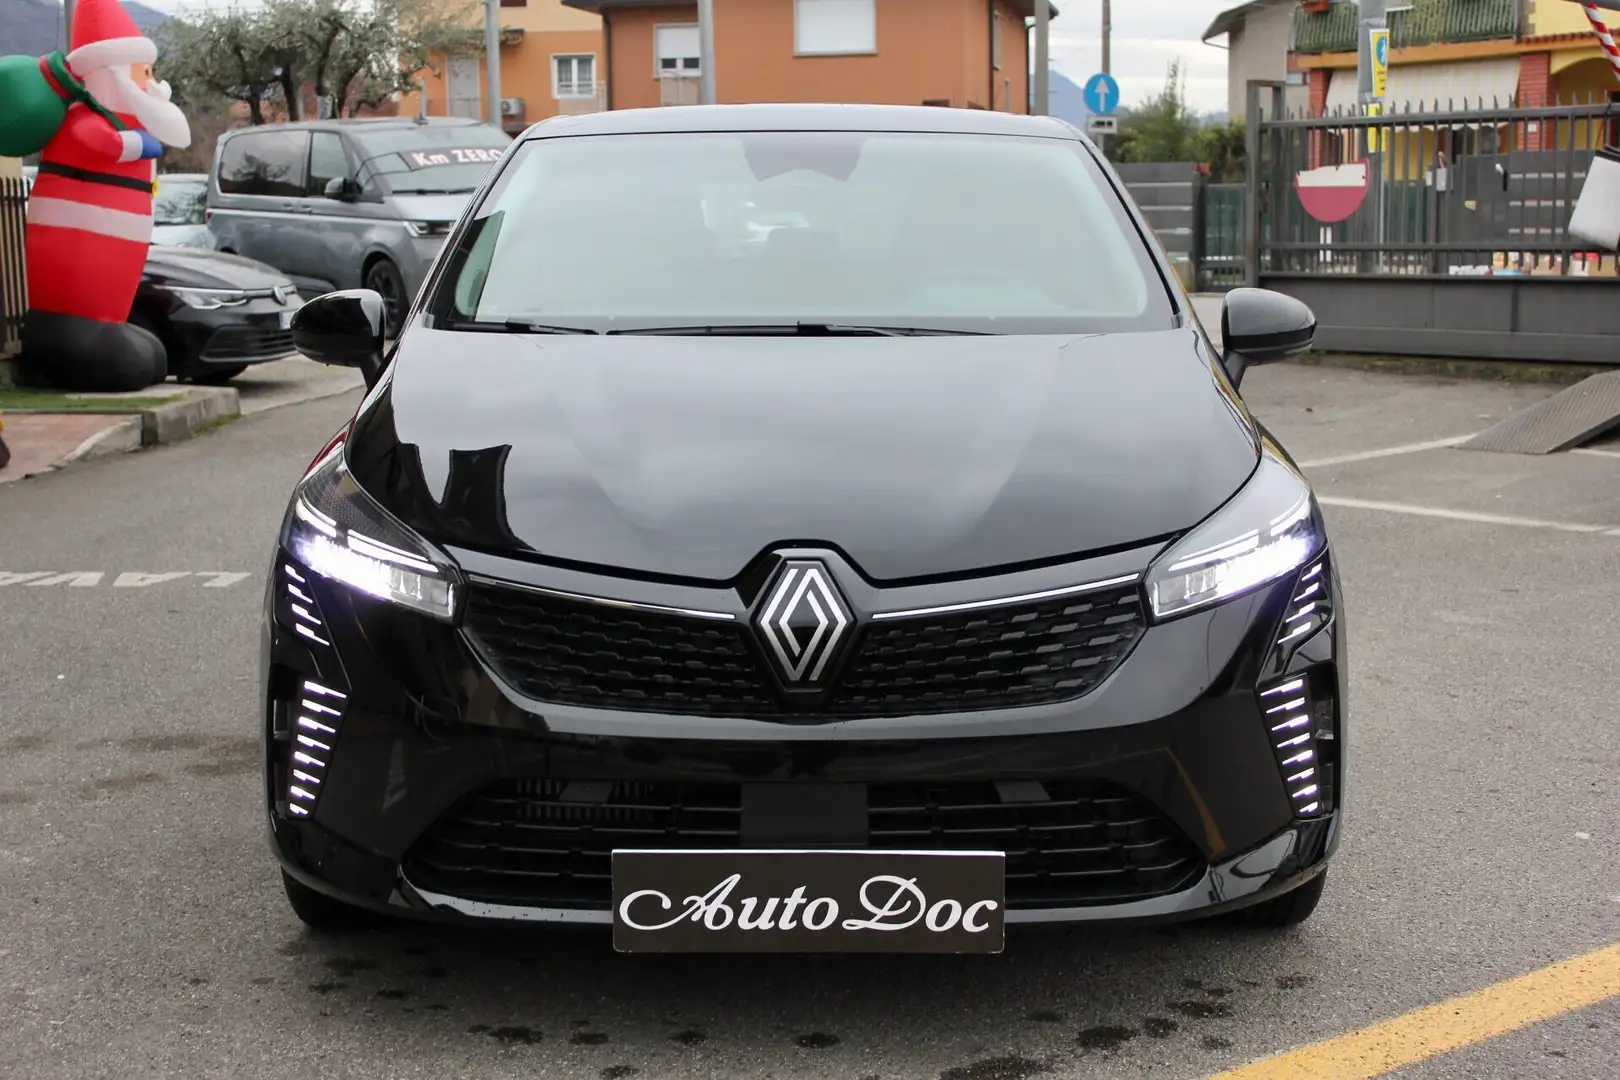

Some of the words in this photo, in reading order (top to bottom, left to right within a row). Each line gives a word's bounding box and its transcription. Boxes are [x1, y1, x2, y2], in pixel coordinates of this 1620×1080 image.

[412, 152, 450, 166] Km
[619, 873, 839, 931] Auto
[841, 875, 998, 932] Doc
